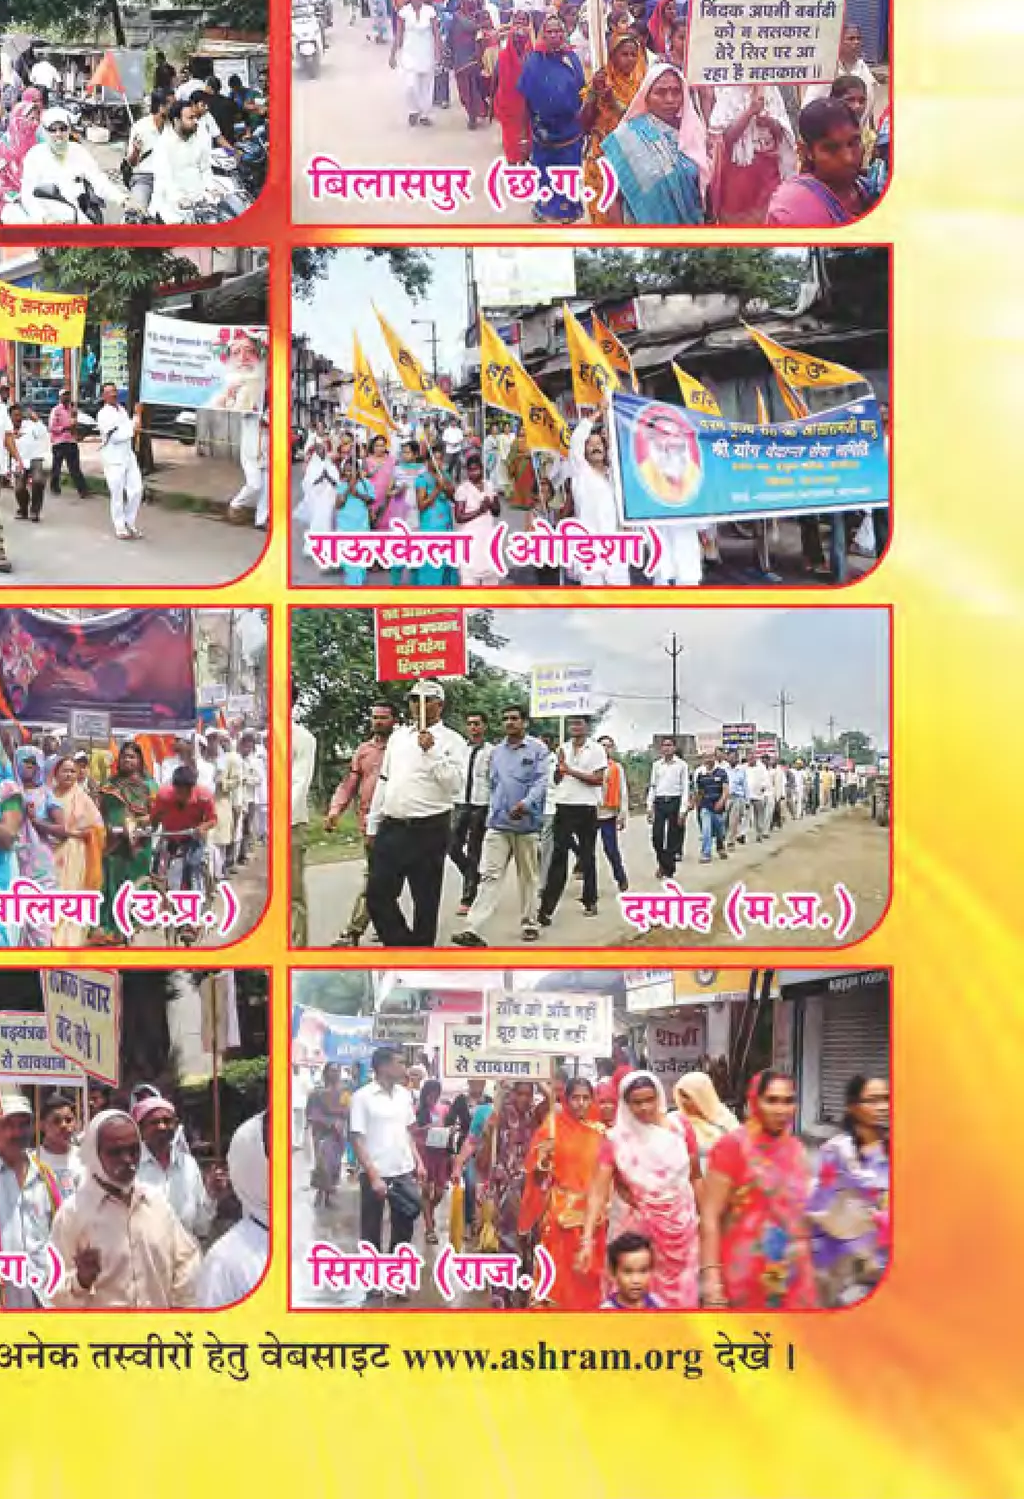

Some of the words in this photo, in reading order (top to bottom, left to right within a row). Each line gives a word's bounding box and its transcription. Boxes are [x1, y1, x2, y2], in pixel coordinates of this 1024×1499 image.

[700, 0, 744, 19] निंदक
[714, 21, 735, 39] को
[740, 40, 768, 60] सिर
[773, 46, 792, 58] पर
[796, 46, 816, 58] आ
[90, 1332, 193, 1370] तस्वीरों
[203, 1332, 248, 1379] हेतु
[259, 1332, 389, 1377] वेबसाइट
[404, 1342, 702, 1378] www.ashram.org
[715, 1332, 770, 1370] देखें
